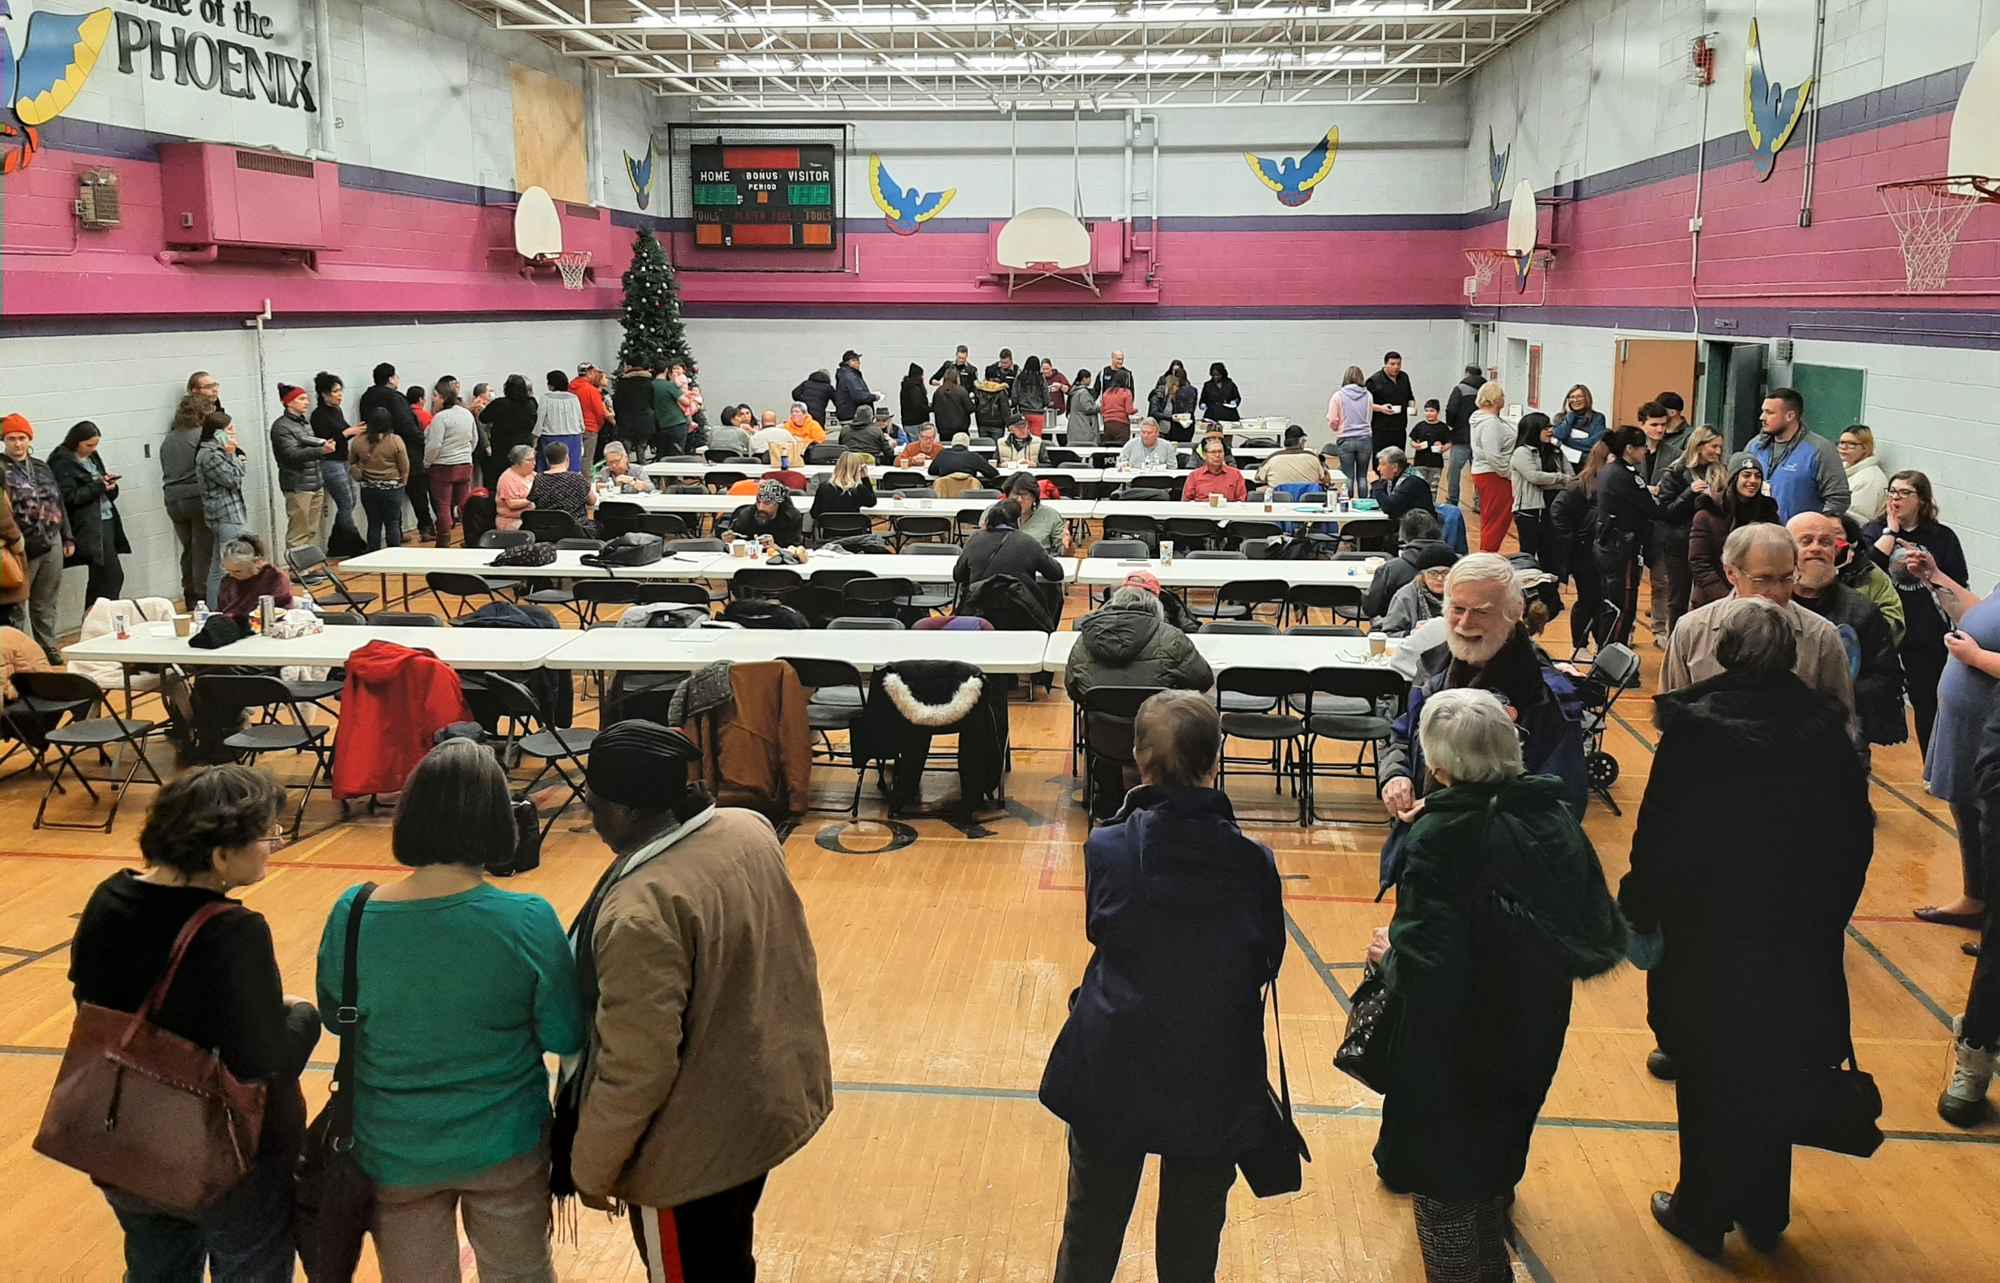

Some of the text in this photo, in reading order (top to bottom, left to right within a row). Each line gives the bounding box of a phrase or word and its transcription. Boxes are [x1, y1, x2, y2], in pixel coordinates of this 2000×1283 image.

[126, 0, 275, 39] me of the
[114, 11, 317, 113] PHOENIX
[700, 171, 730, 181] HOME
[746, 171, 778, 180] BONUS
[788, 170, 830, 182] VISITOR
